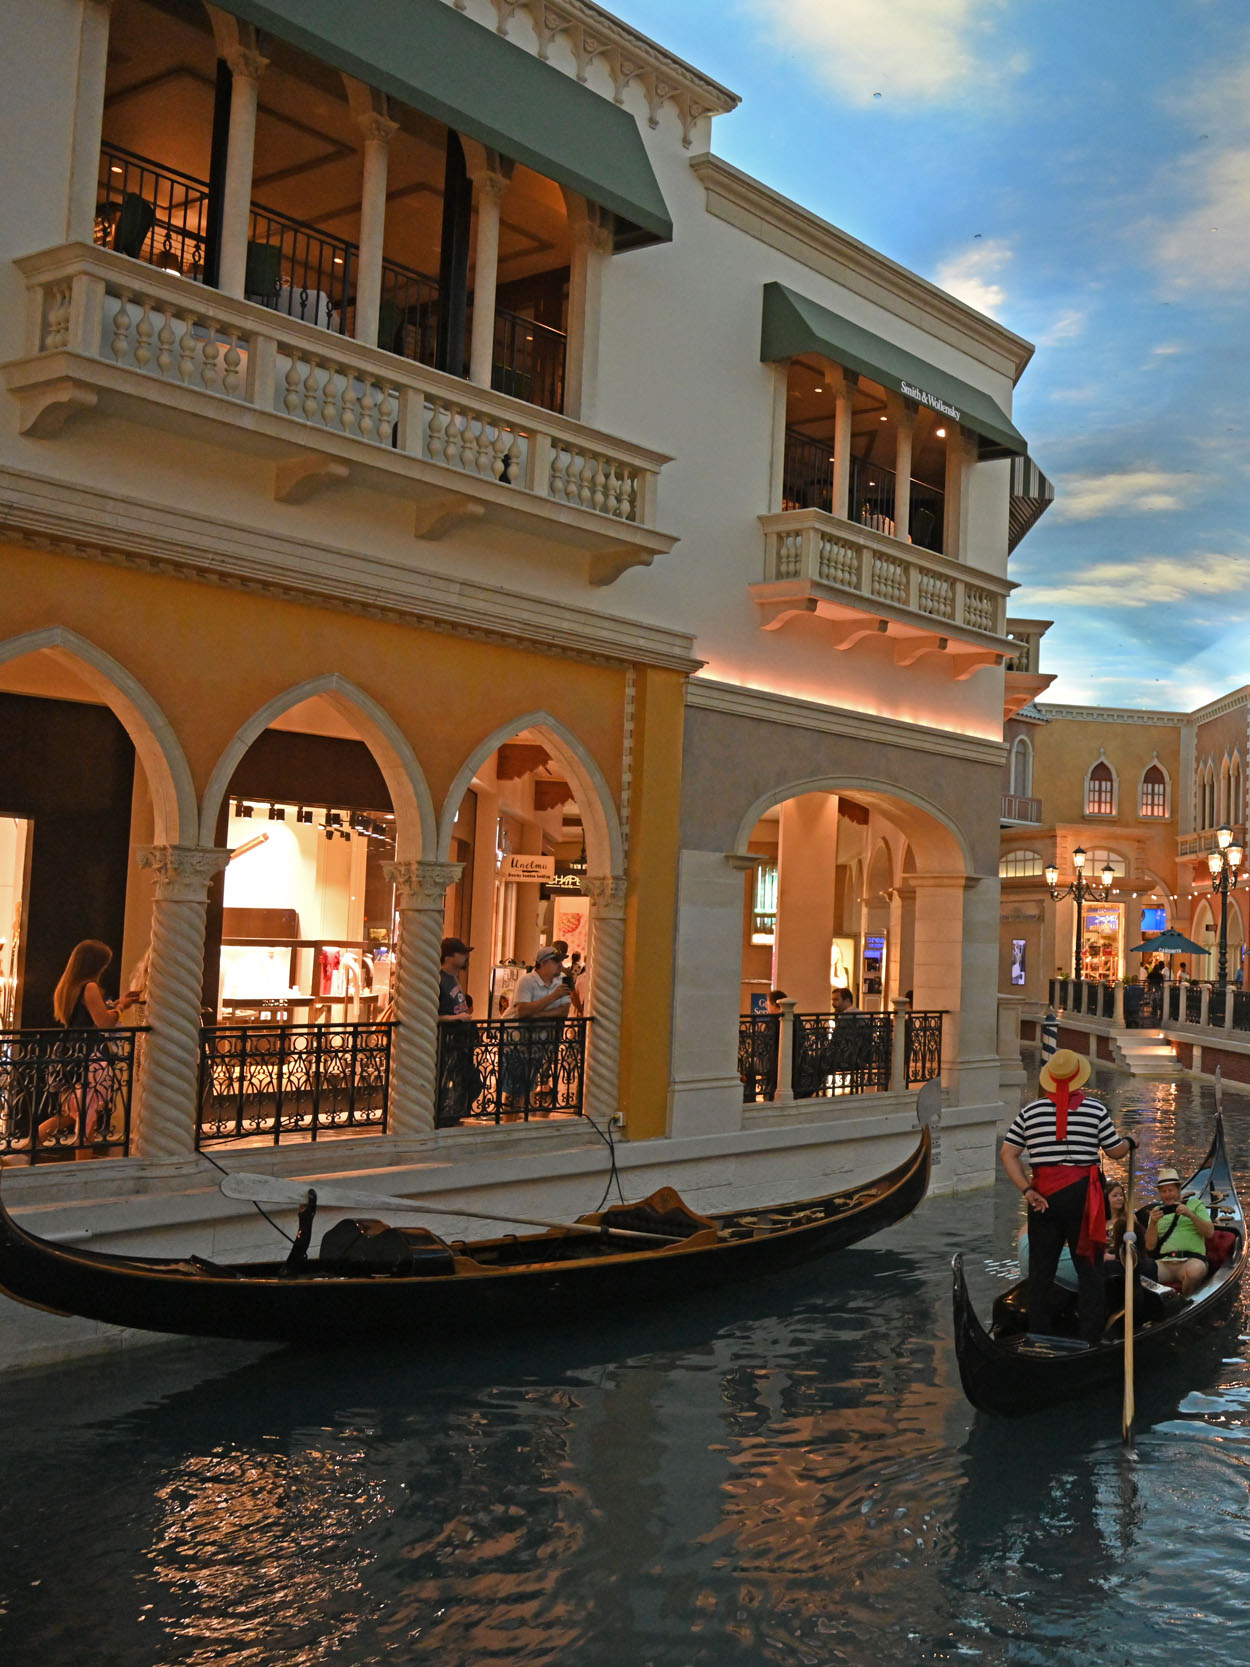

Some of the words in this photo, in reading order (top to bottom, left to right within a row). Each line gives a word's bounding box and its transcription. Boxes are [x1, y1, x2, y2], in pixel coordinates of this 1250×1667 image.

[900, 380, 921, 401] Smith
[922, 391, 928, 404] &
[928, 394, 961, 421] Wollensky
